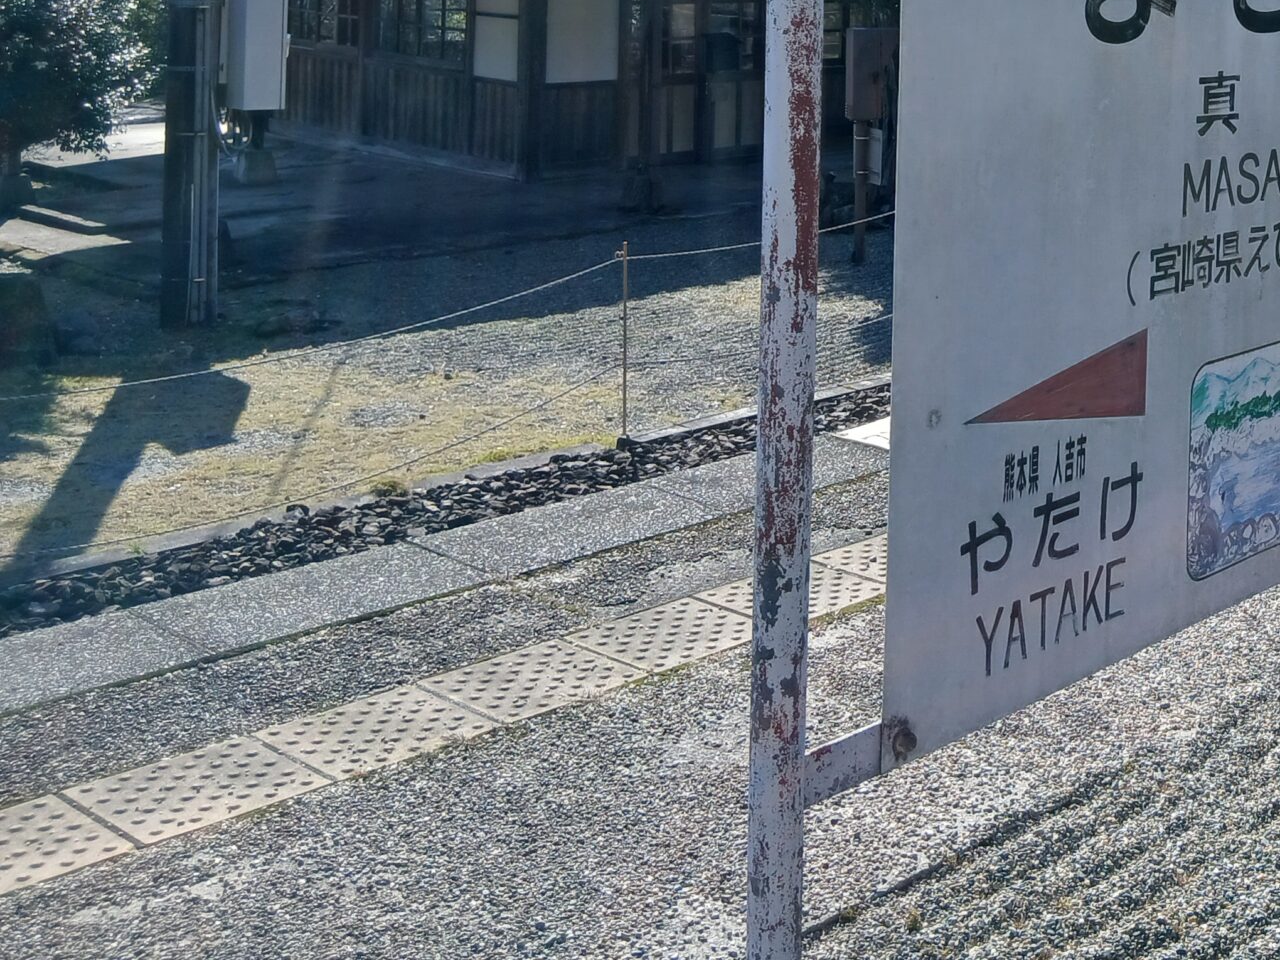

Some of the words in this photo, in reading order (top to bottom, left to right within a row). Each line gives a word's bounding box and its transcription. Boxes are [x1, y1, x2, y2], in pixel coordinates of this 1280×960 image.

[1002, 445, 1040, 503] 熊本県
[1052, 433, 1087, 486] 人吉市
[960, 461, 1144, 596] やたけ
[975, 557, 1126, 677] YATAKE
